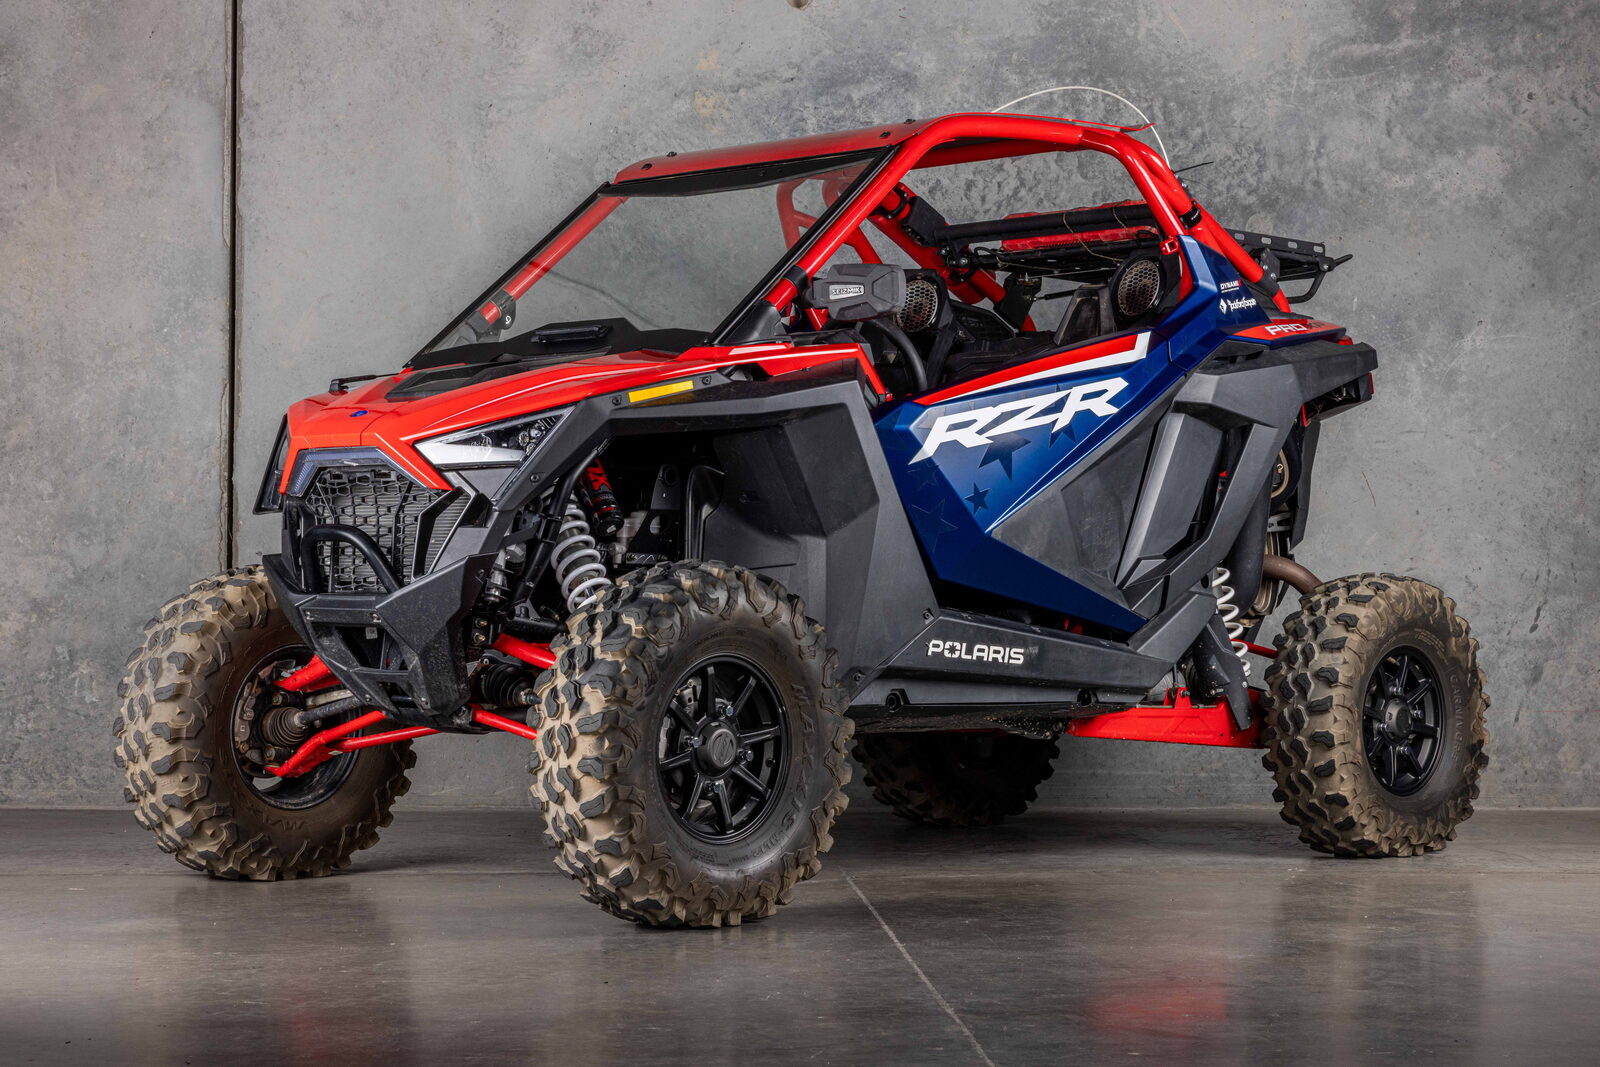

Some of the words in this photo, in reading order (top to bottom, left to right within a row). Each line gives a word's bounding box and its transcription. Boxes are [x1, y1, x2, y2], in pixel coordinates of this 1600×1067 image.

[1264, 323, 1308, 335] PRO
[908, 377, 1129, 465] RZR
[927, 639, 1025, 664] POLARIS
